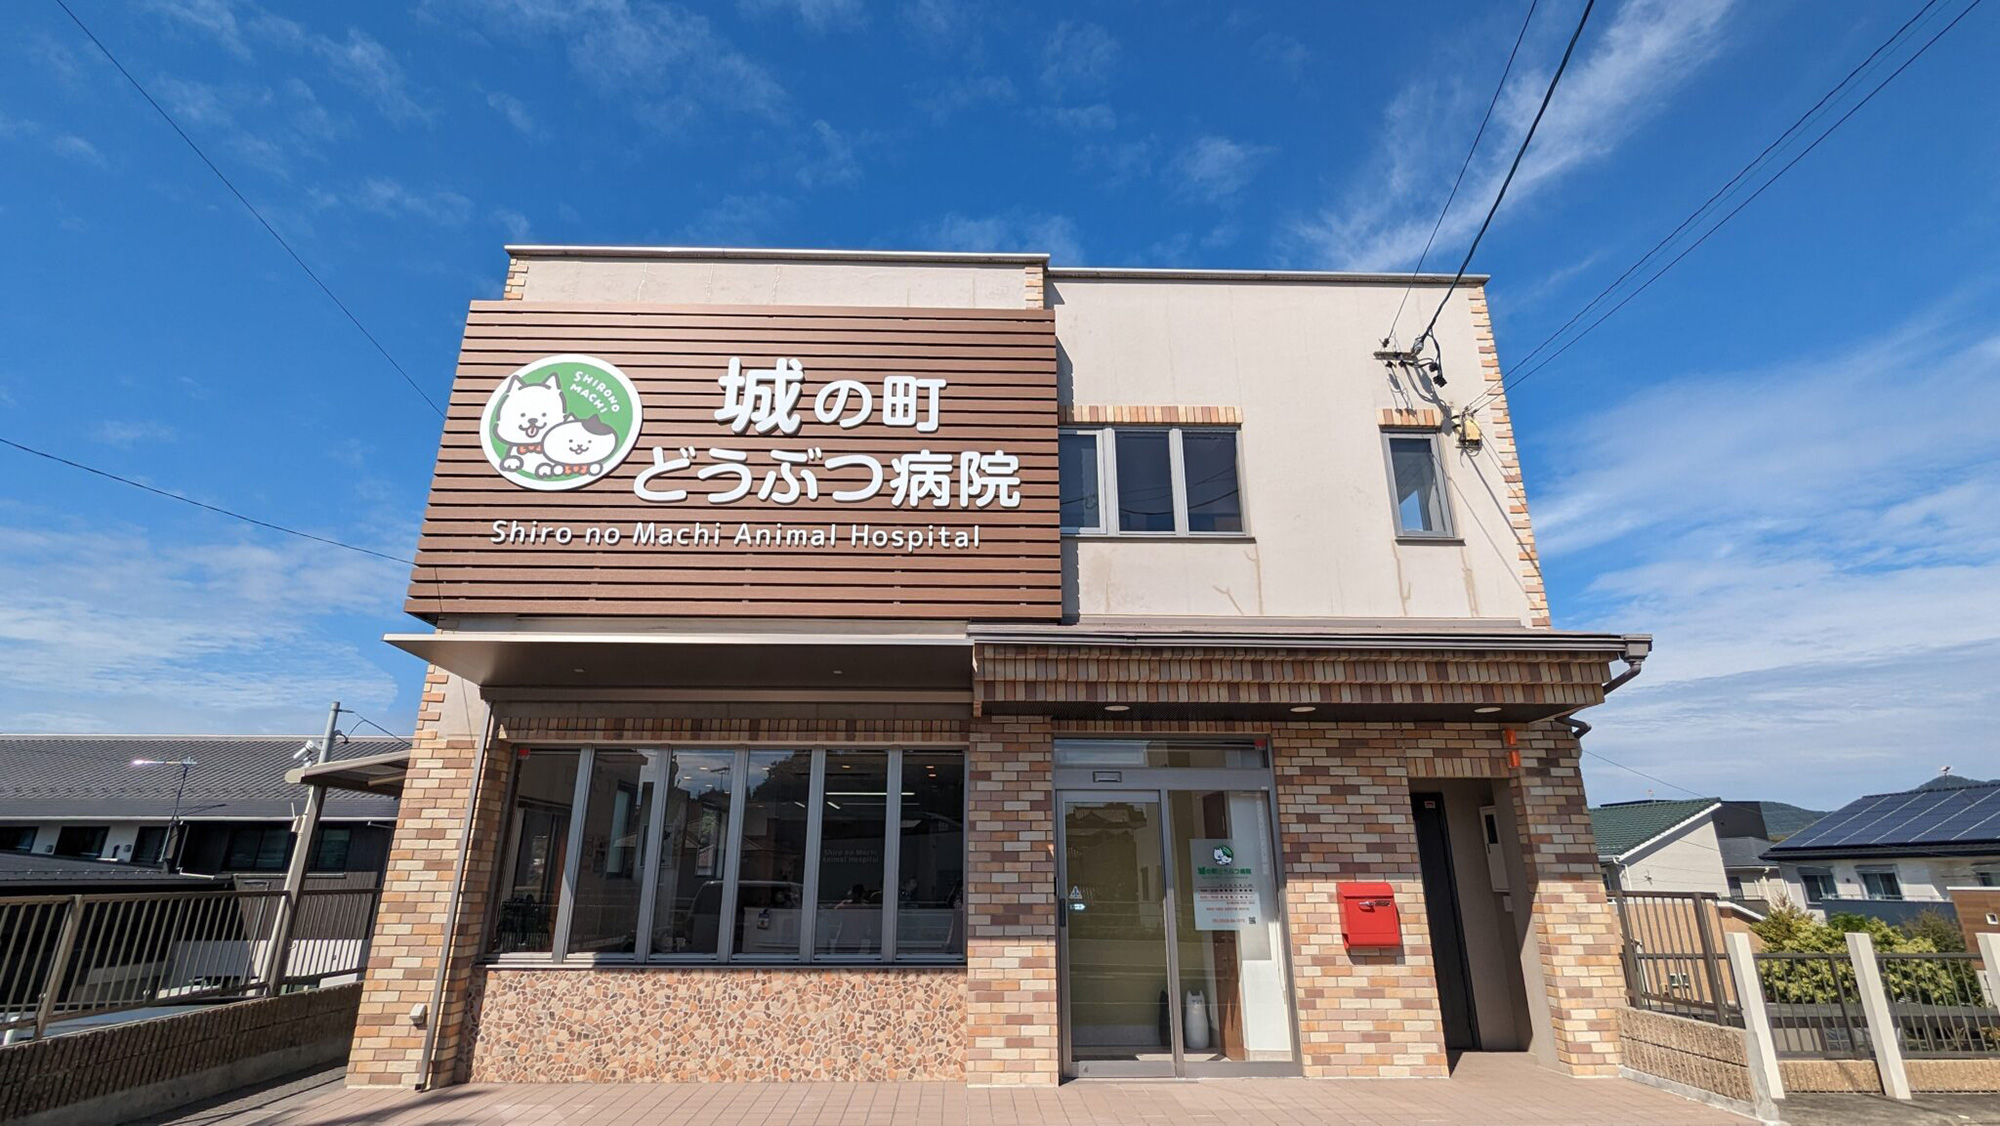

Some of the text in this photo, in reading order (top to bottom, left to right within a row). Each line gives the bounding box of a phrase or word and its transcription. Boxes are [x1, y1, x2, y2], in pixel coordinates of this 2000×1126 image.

[570, 384, 608, 413] MACHI
[573, 371, 620, 413] SHIRONO
[714, 357, 947, 433] 城の町
[632, 446, 1021, 508] どうぶつ病院
[490, 520, 979, 552] Shiro no Machi Animal Hospital
